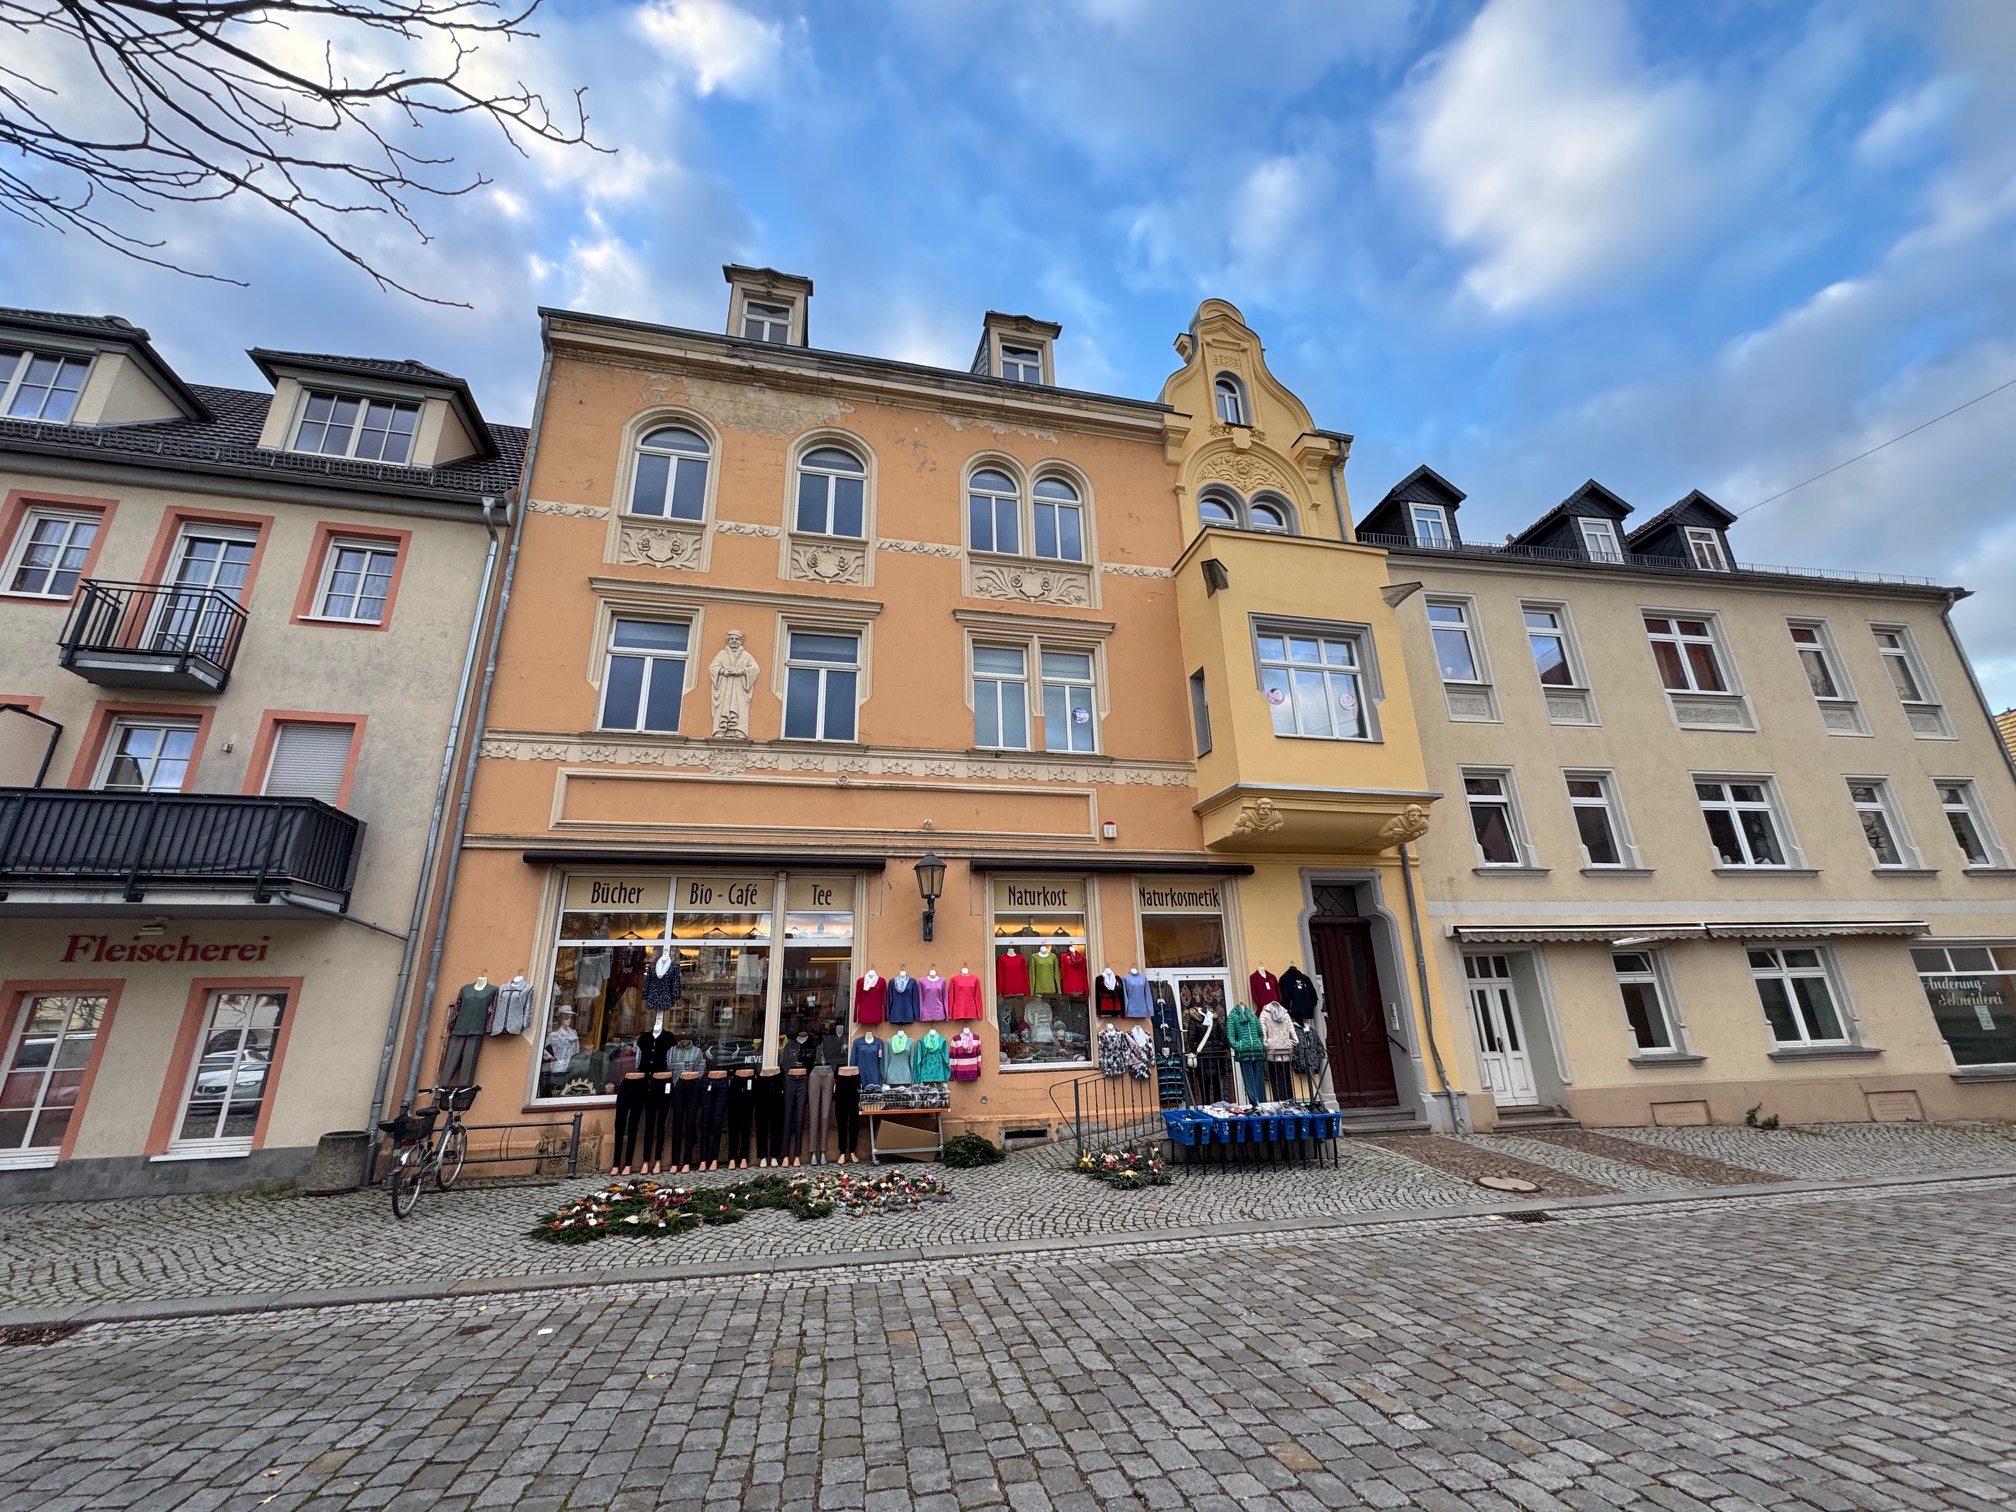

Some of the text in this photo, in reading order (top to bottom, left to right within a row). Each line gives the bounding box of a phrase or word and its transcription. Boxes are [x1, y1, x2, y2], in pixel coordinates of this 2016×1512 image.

[590, 881, 644, 904] Bücher
[689, 882, 712, 905] Bio
[728, 883, 757, 907] Café
[811, 884, 832, 906] Tee
[1008, 886, 1068, 907] Naturkost
[1139, 886, 1220, 908] Naturkosmetik
[59, 934, 270, 962] Fleischerei
[1938, 991, 2003, 1006] Schneiderei
